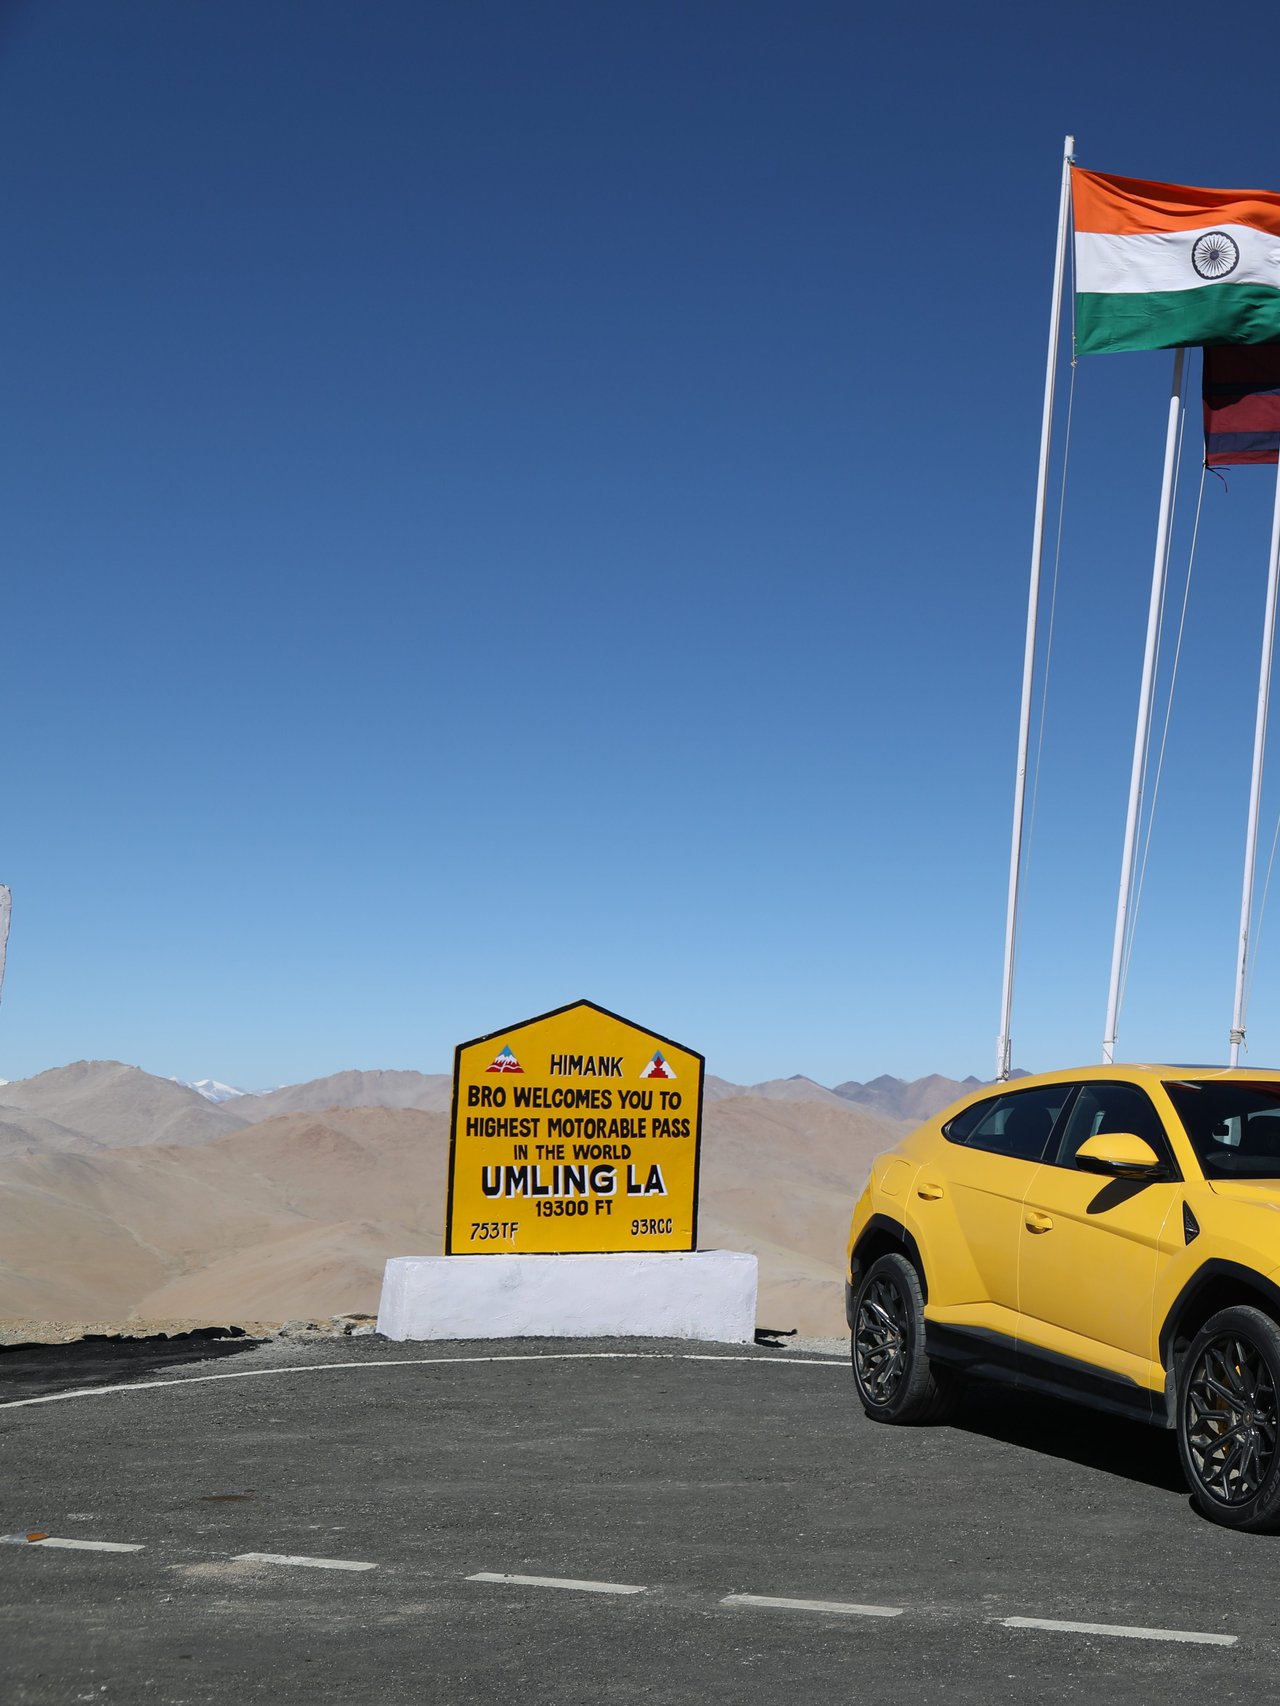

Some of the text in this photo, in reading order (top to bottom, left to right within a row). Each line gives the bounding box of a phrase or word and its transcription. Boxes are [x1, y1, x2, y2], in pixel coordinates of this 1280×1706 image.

[550, 1054, 624, 1077] HIMANK
[467, 1085, 682, 1110] BRO WELCOMES YOU TO
[466, 1117, 690, 1139] HIGHEST MOTORABLE PASS
[513, 1144, 631, 1160] IN THE WORLD
[481, 1164, 668, 1198] UMLING LA
[535, 1200, 613, 1217] 19300 FT
[470, 1222, 519, 1240] 753TF
[631, 1218, 673, 1236] 93RCC
